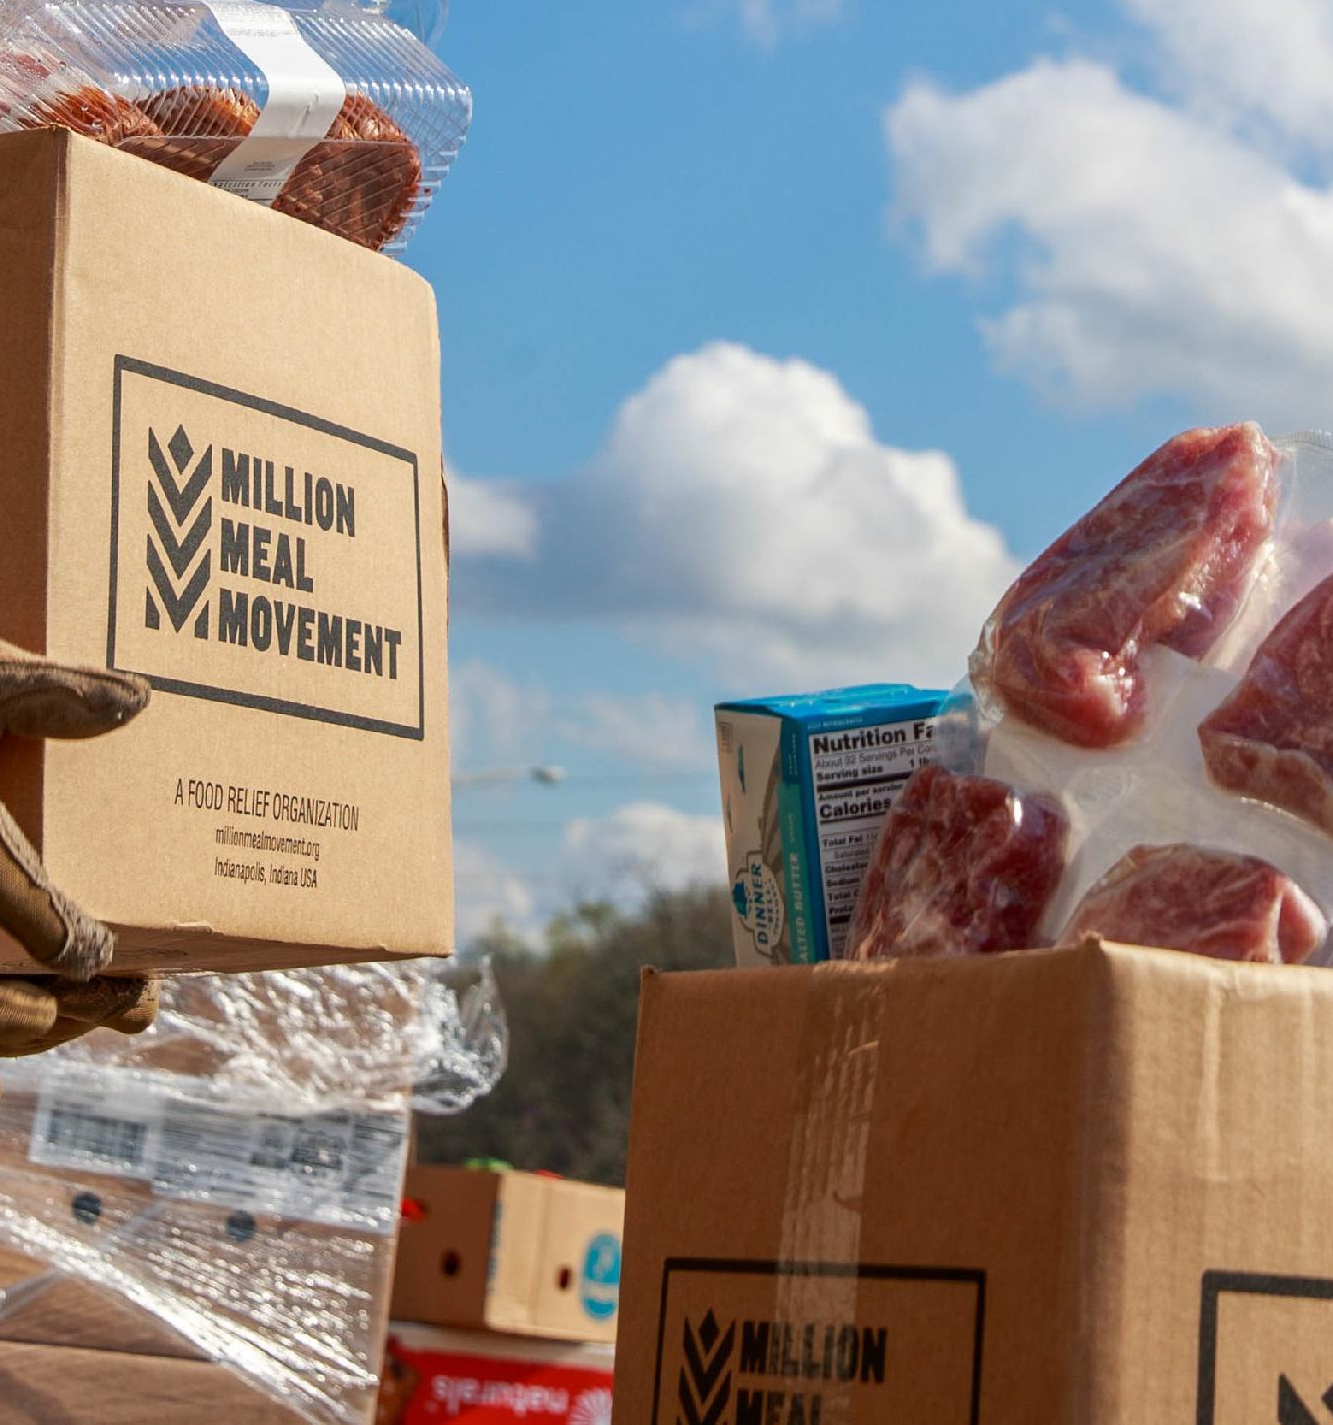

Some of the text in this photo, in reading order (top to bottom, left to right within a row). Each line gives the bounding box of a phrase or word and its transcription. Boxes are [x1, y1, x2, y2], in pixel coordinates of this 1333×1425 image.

[221, 447, 356, 537] MILLION
[220, 517, 314, 592] MEAL
[218, 587, 402, 679] MOVEMENT
[813, 727, 906, 754] Nutrition
[817, 768, 858, 781] Serving
[861, 766, 883, 775] size
[174, 778, 359, 831] A FOOD RELIEF ORGANIZATION
[819, 797, 891, 818] Calories
[215, 825, 320, 861] millionmealmovement.org
[214, 856, 317, 888] Indianapolis, Indiana USA
[789, 852, 803, 910] BUTTER
[751, 863, 768, 944] DINNER
[795, 916, 808, 961] ALTED
[738, 1321, 887, 1383] MILLION
